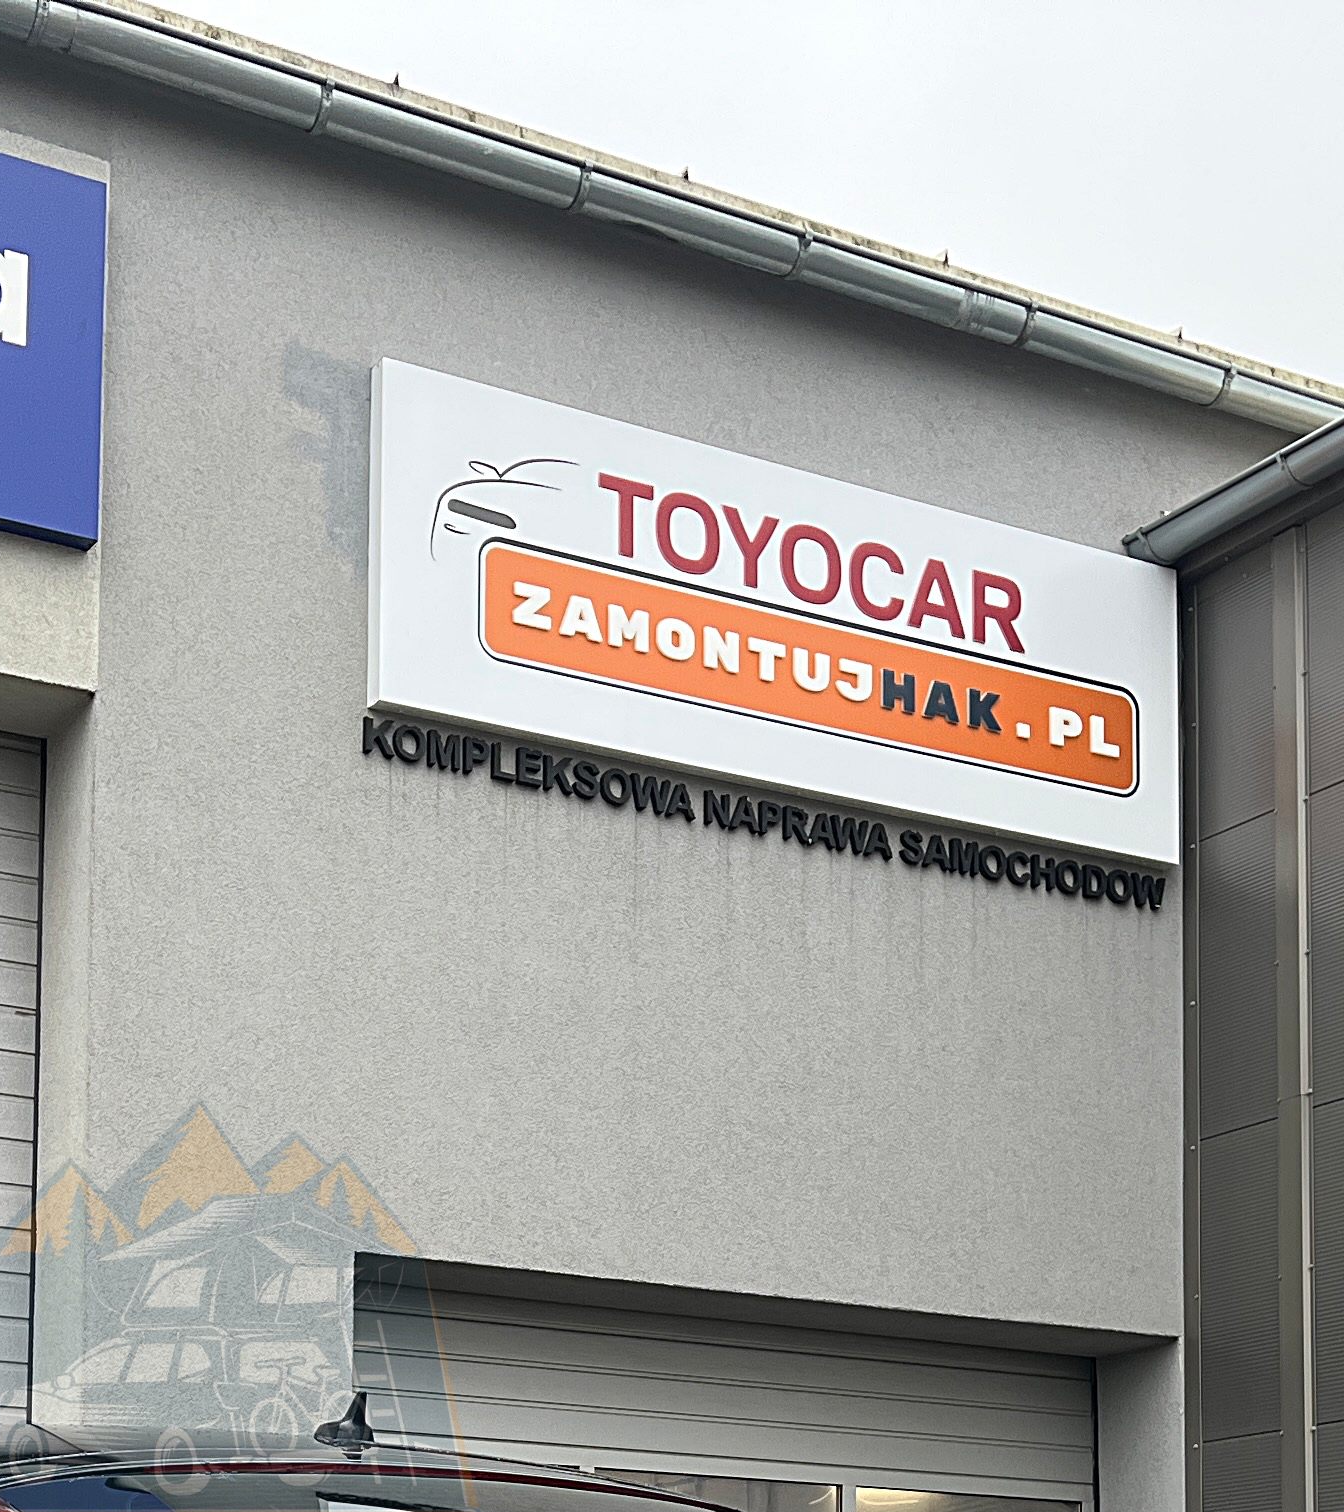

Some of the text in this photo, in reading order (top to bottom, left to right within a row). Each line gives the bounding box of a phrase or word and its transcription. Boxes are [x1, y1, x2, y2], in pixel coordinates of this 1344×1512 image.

[597, 472, 1026, 655] TOYOCAR
[362, 716, 695, 822] KOMPLEKSOWA
[703, 789, 893, 862] NAPRAWA
